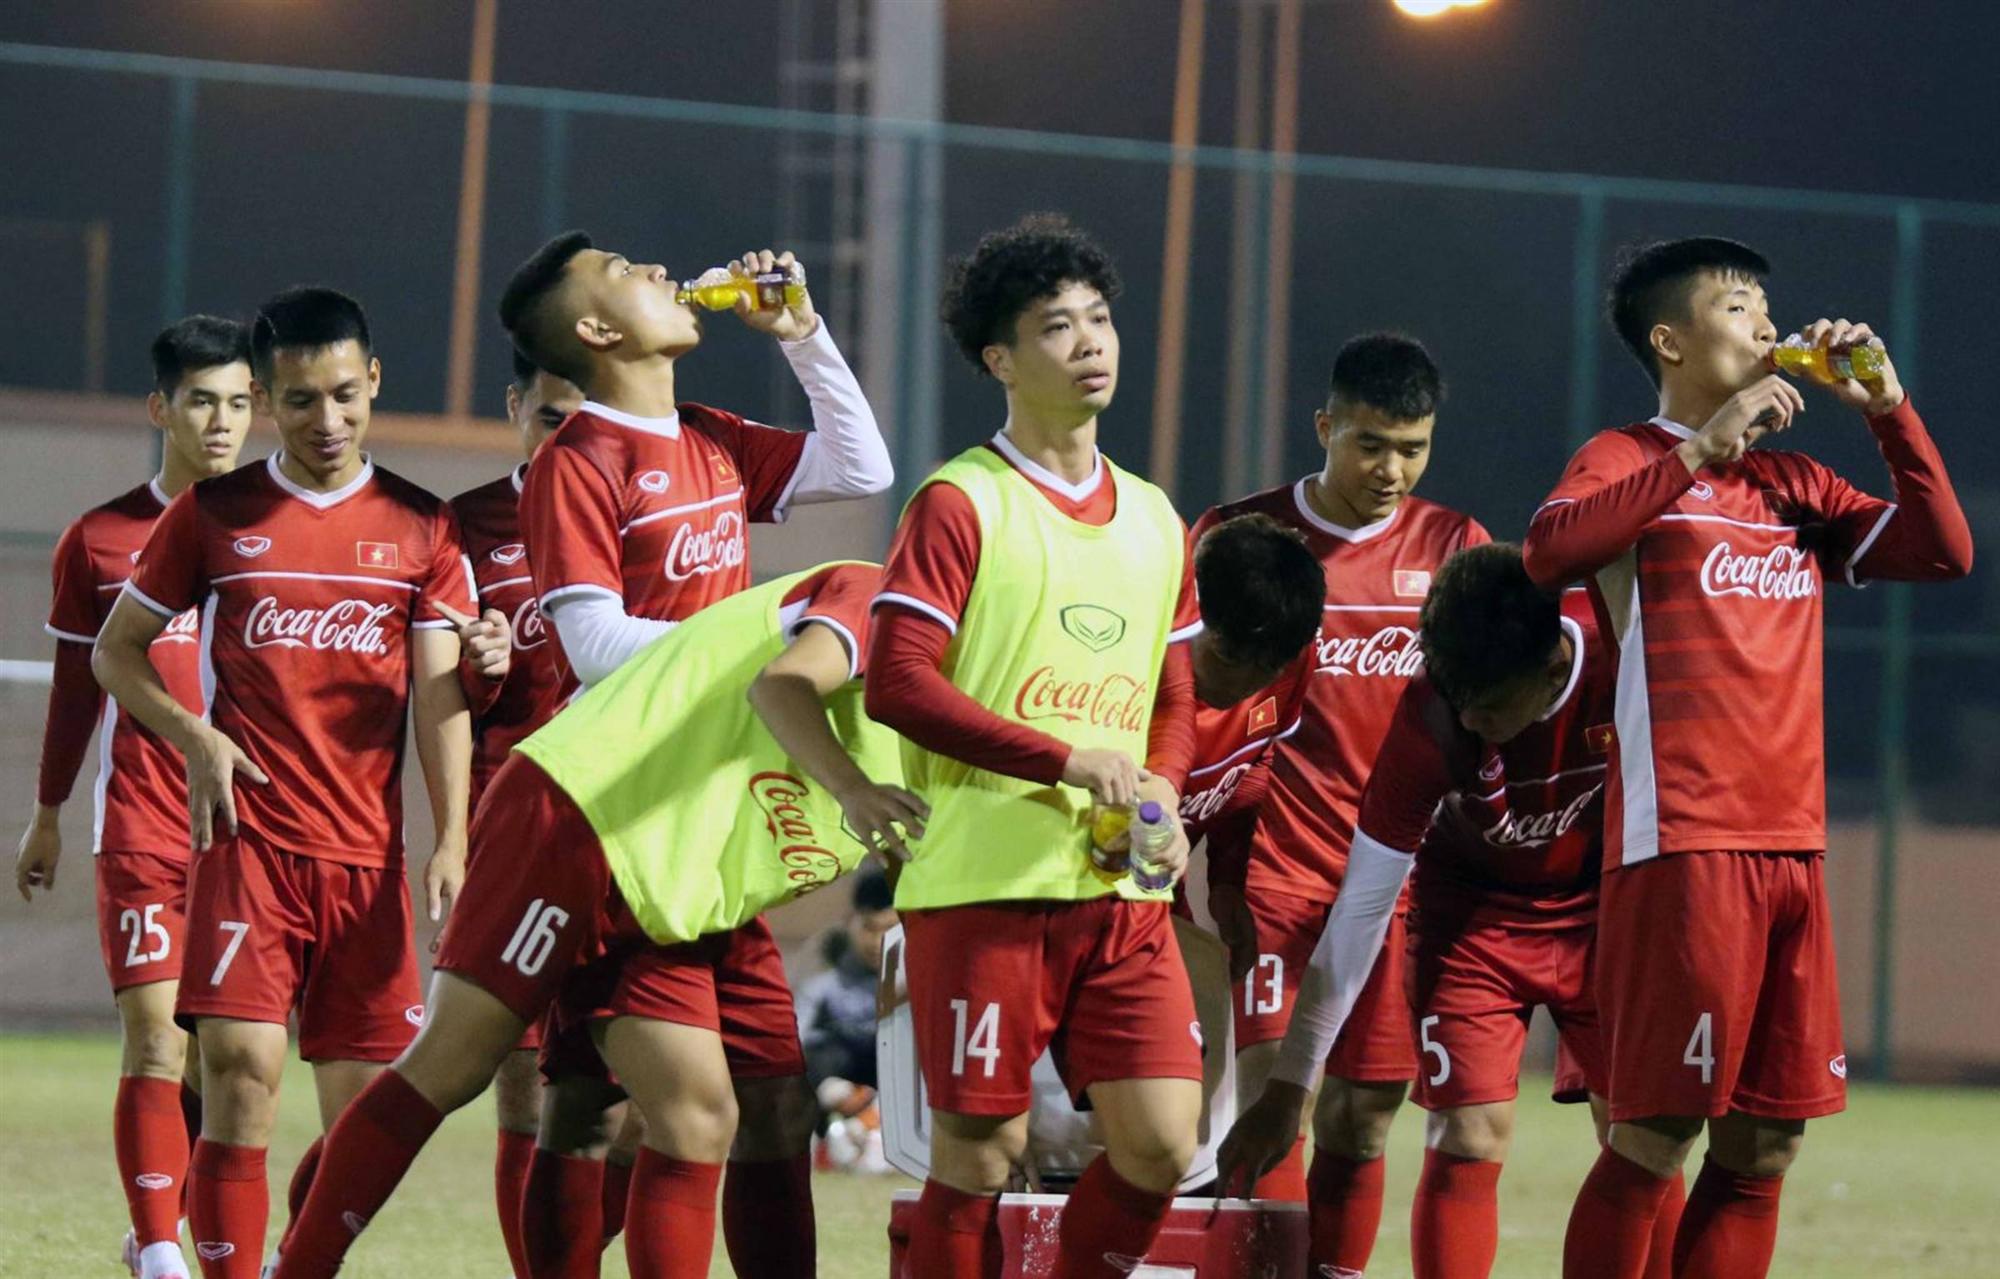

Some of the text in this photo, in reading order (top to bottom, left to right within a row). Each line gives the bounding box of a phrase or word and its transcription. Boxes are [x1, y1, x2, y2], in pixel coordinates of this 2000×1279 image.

[120, 903, 172, 968] 25
[210, 920, 251, 987] 7
[501, 898, 569, 976] 16
[1245, 953, 1284, 1016] 13
[950, 998, 1000, 1079] 14
[1421, 1014, 1451, 1086] 5
[1683, 1012, 1715, 1083] 4
